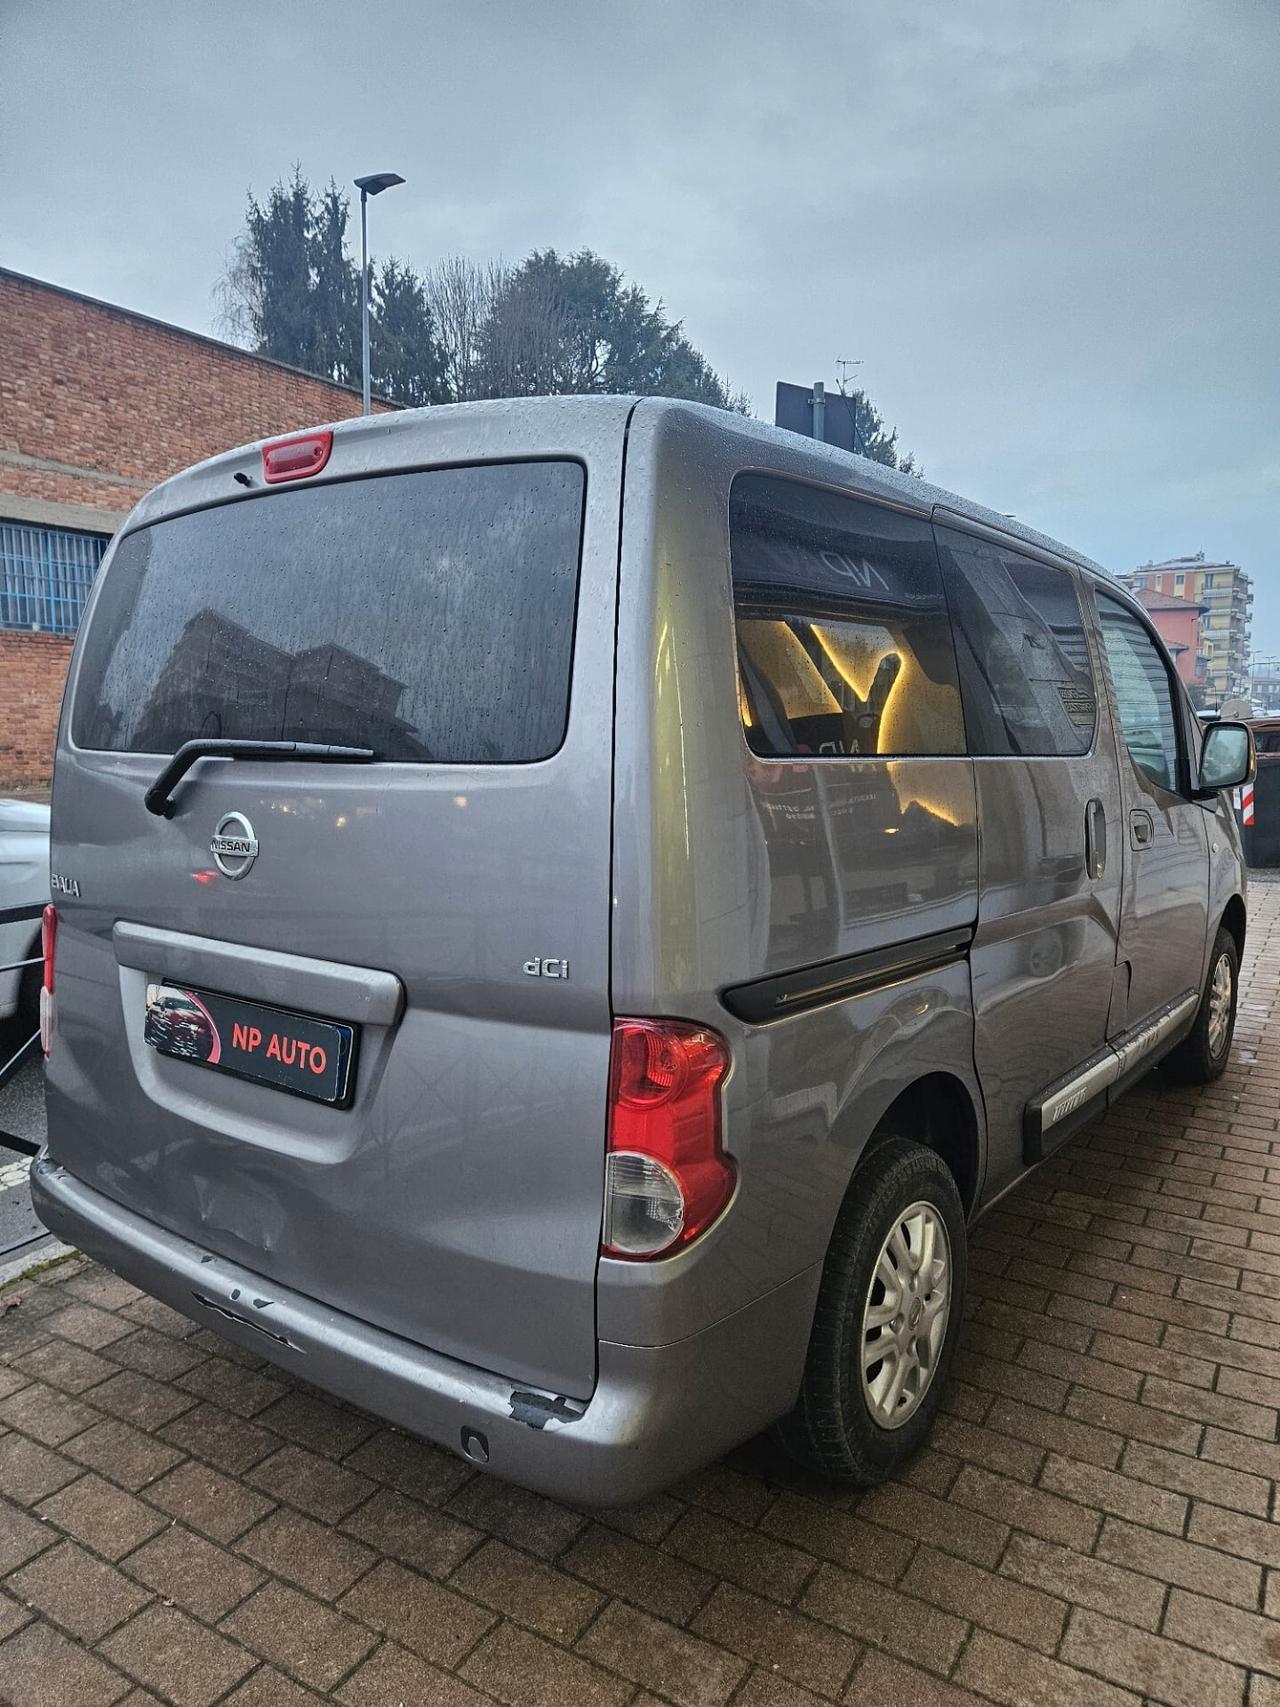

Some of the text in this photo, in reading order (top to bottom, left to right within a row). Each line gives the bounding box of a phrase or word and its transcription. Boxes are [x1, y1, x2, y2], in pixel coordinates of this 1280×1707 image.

[211, 839, 250, 852] NISSAN
[523, 957, 569, 979] dCi
[232, 1022, 327, 1075] NP AUTO
